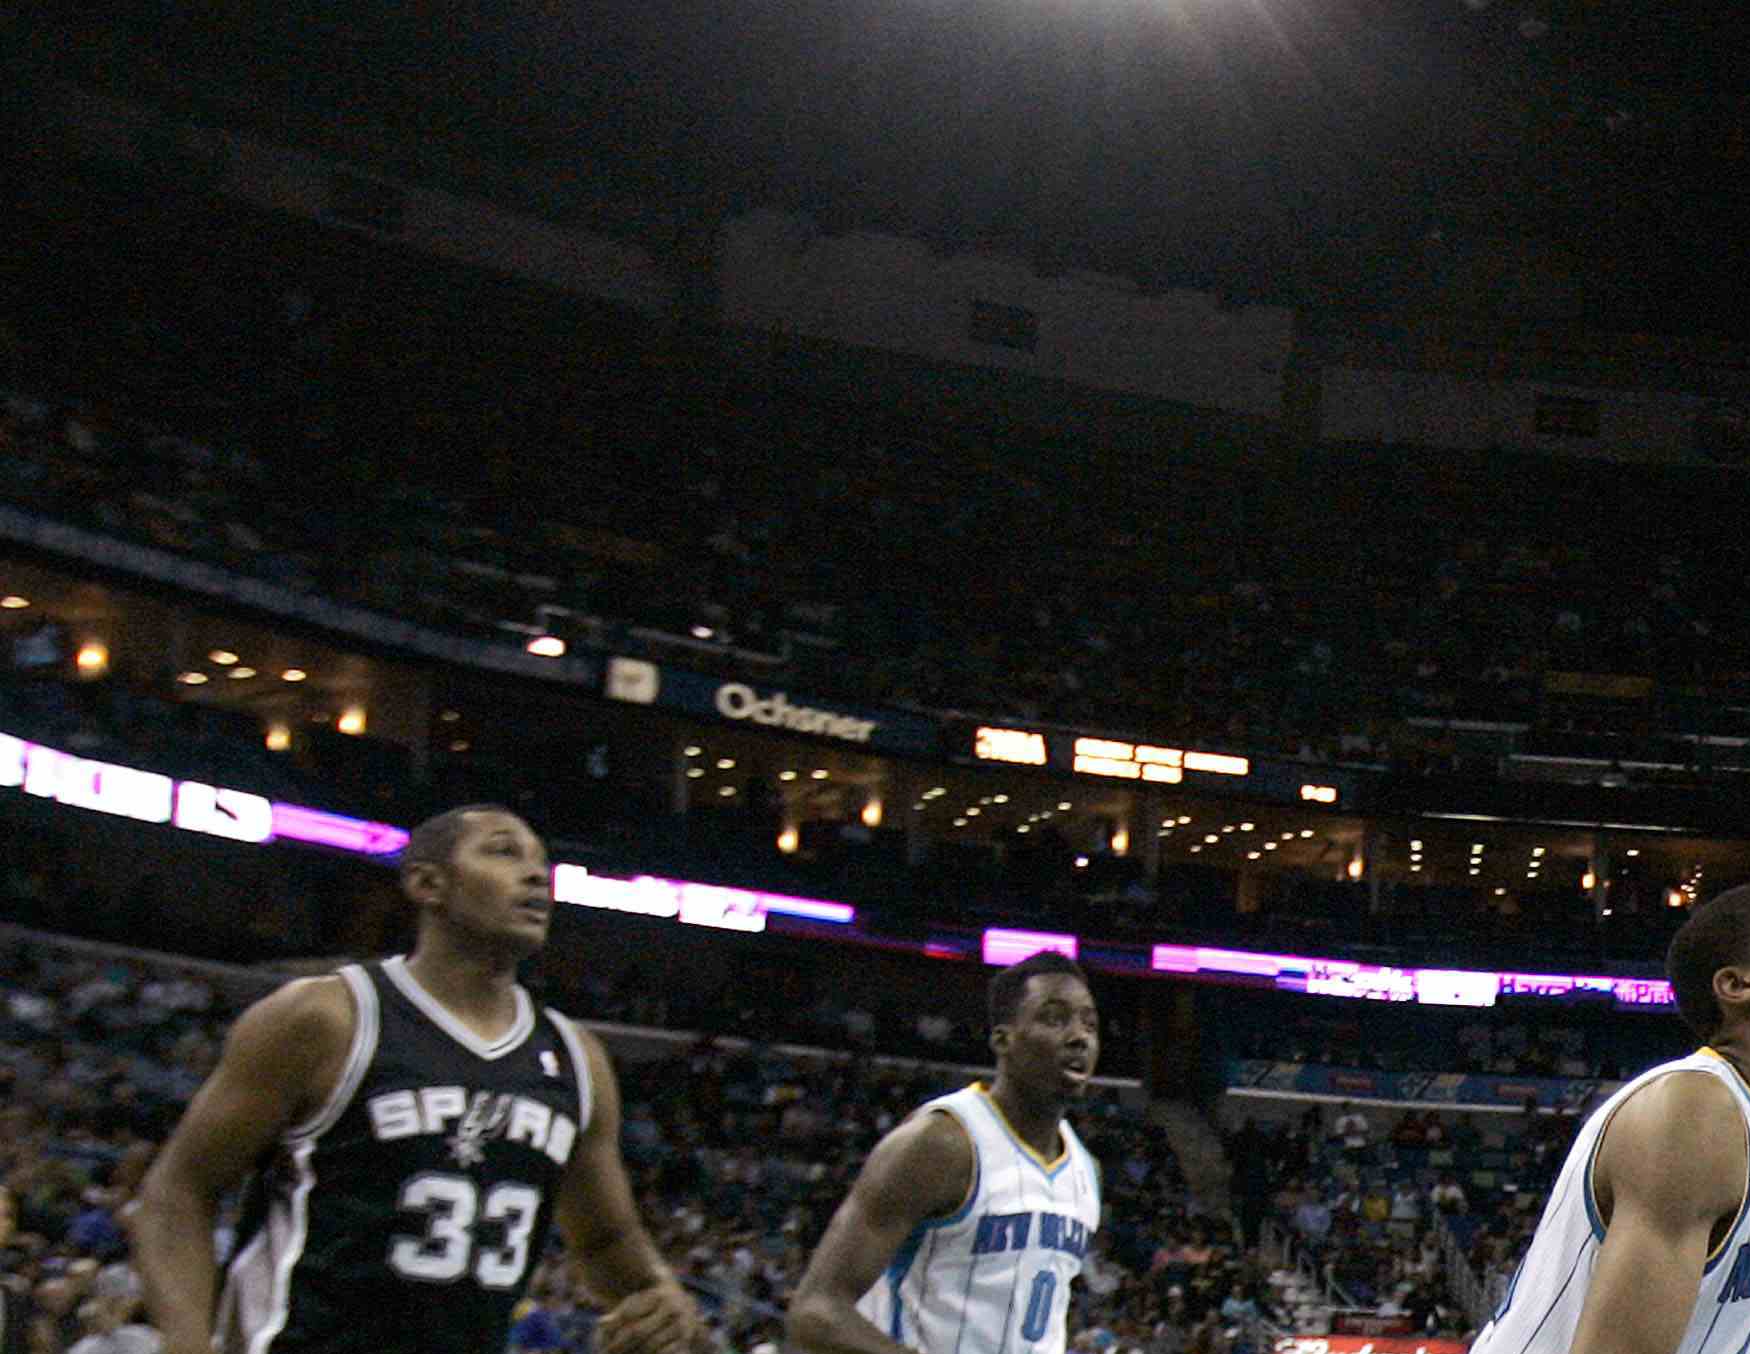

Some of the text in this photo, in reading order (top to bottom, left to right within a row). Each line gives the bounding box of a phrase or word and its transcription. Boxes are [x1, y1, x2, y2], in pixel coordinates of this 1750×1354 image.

[716, 682, 876, 743] Ochsner
[387, 1172, 542, 1291] 33
[1021, 1270, 1057, 1343] 0
